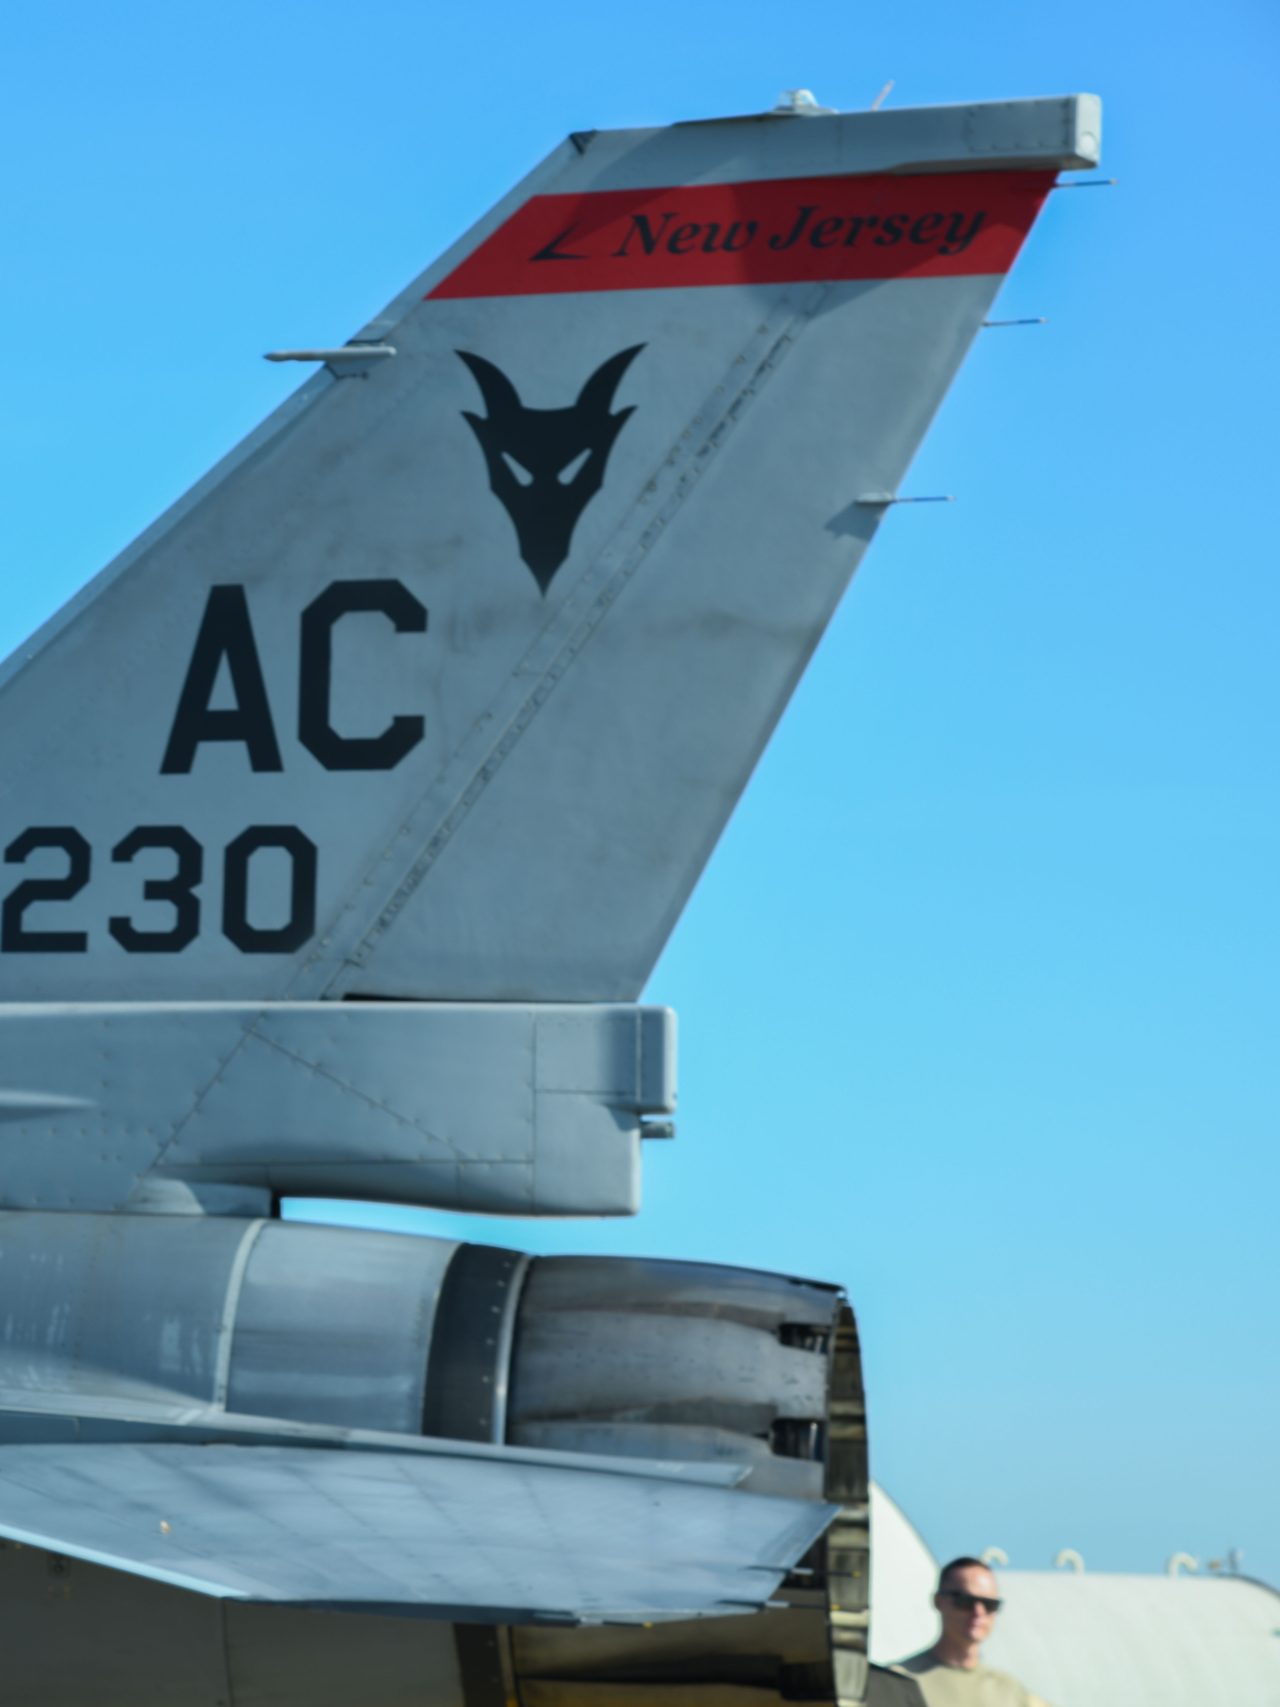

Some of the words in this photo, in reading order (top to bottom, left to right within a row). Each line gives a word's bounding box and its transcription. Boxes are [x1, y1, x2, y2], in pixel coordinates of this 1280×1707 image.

[611, 213, 758, 257] New
[768, 205, 987, 256] Jersey
[160, 579, 428, 775] AC
[0, 825, 317, 953] 230
